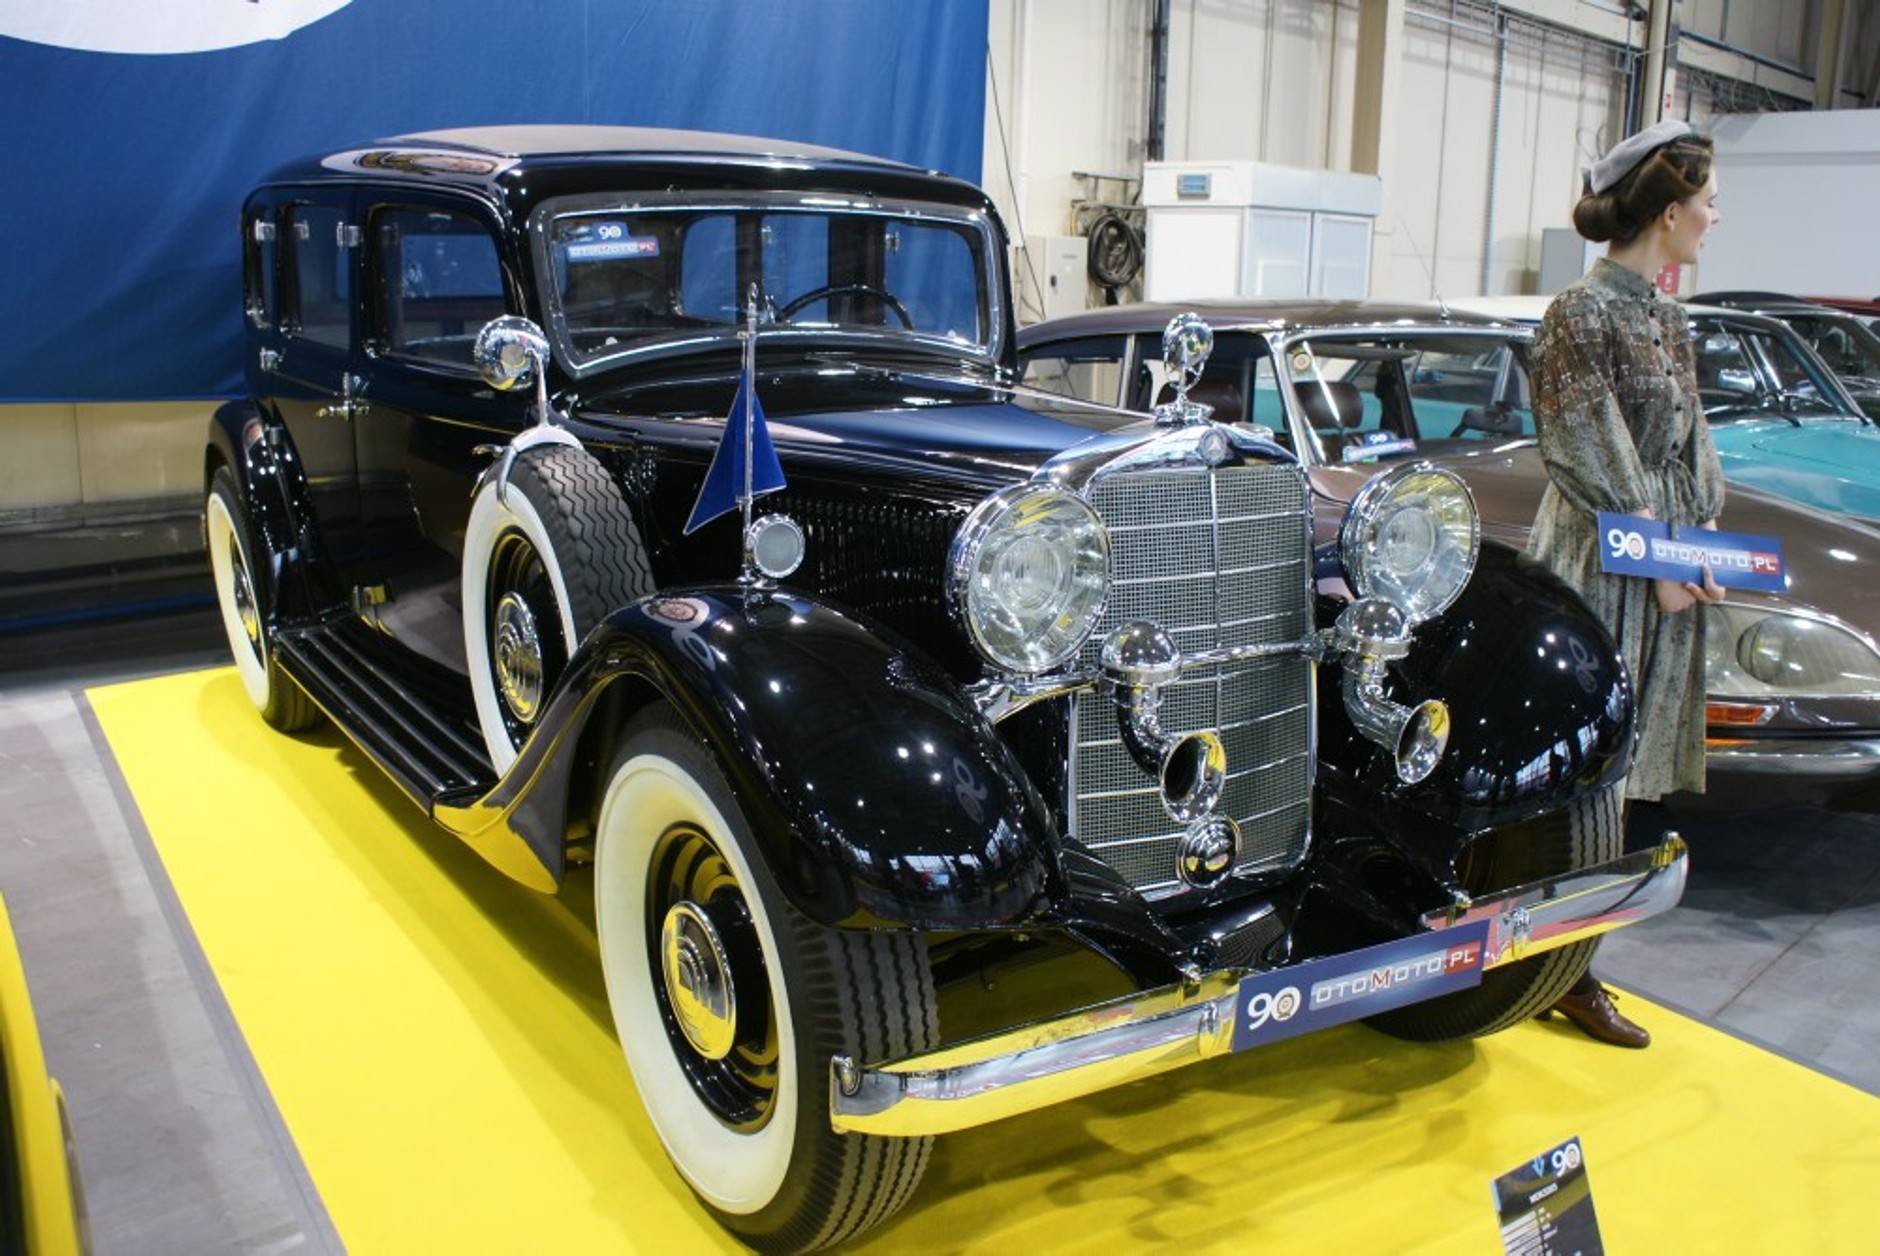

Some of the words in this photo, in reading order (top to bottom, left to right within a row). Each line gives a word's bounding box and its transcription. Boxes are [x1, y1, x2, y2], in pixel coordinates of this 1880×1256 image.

[1607, 528, 1646, 560] 90
[1247, 986, 1302, 1031] 90
[1551, 1143, 1580, 1177] 90
